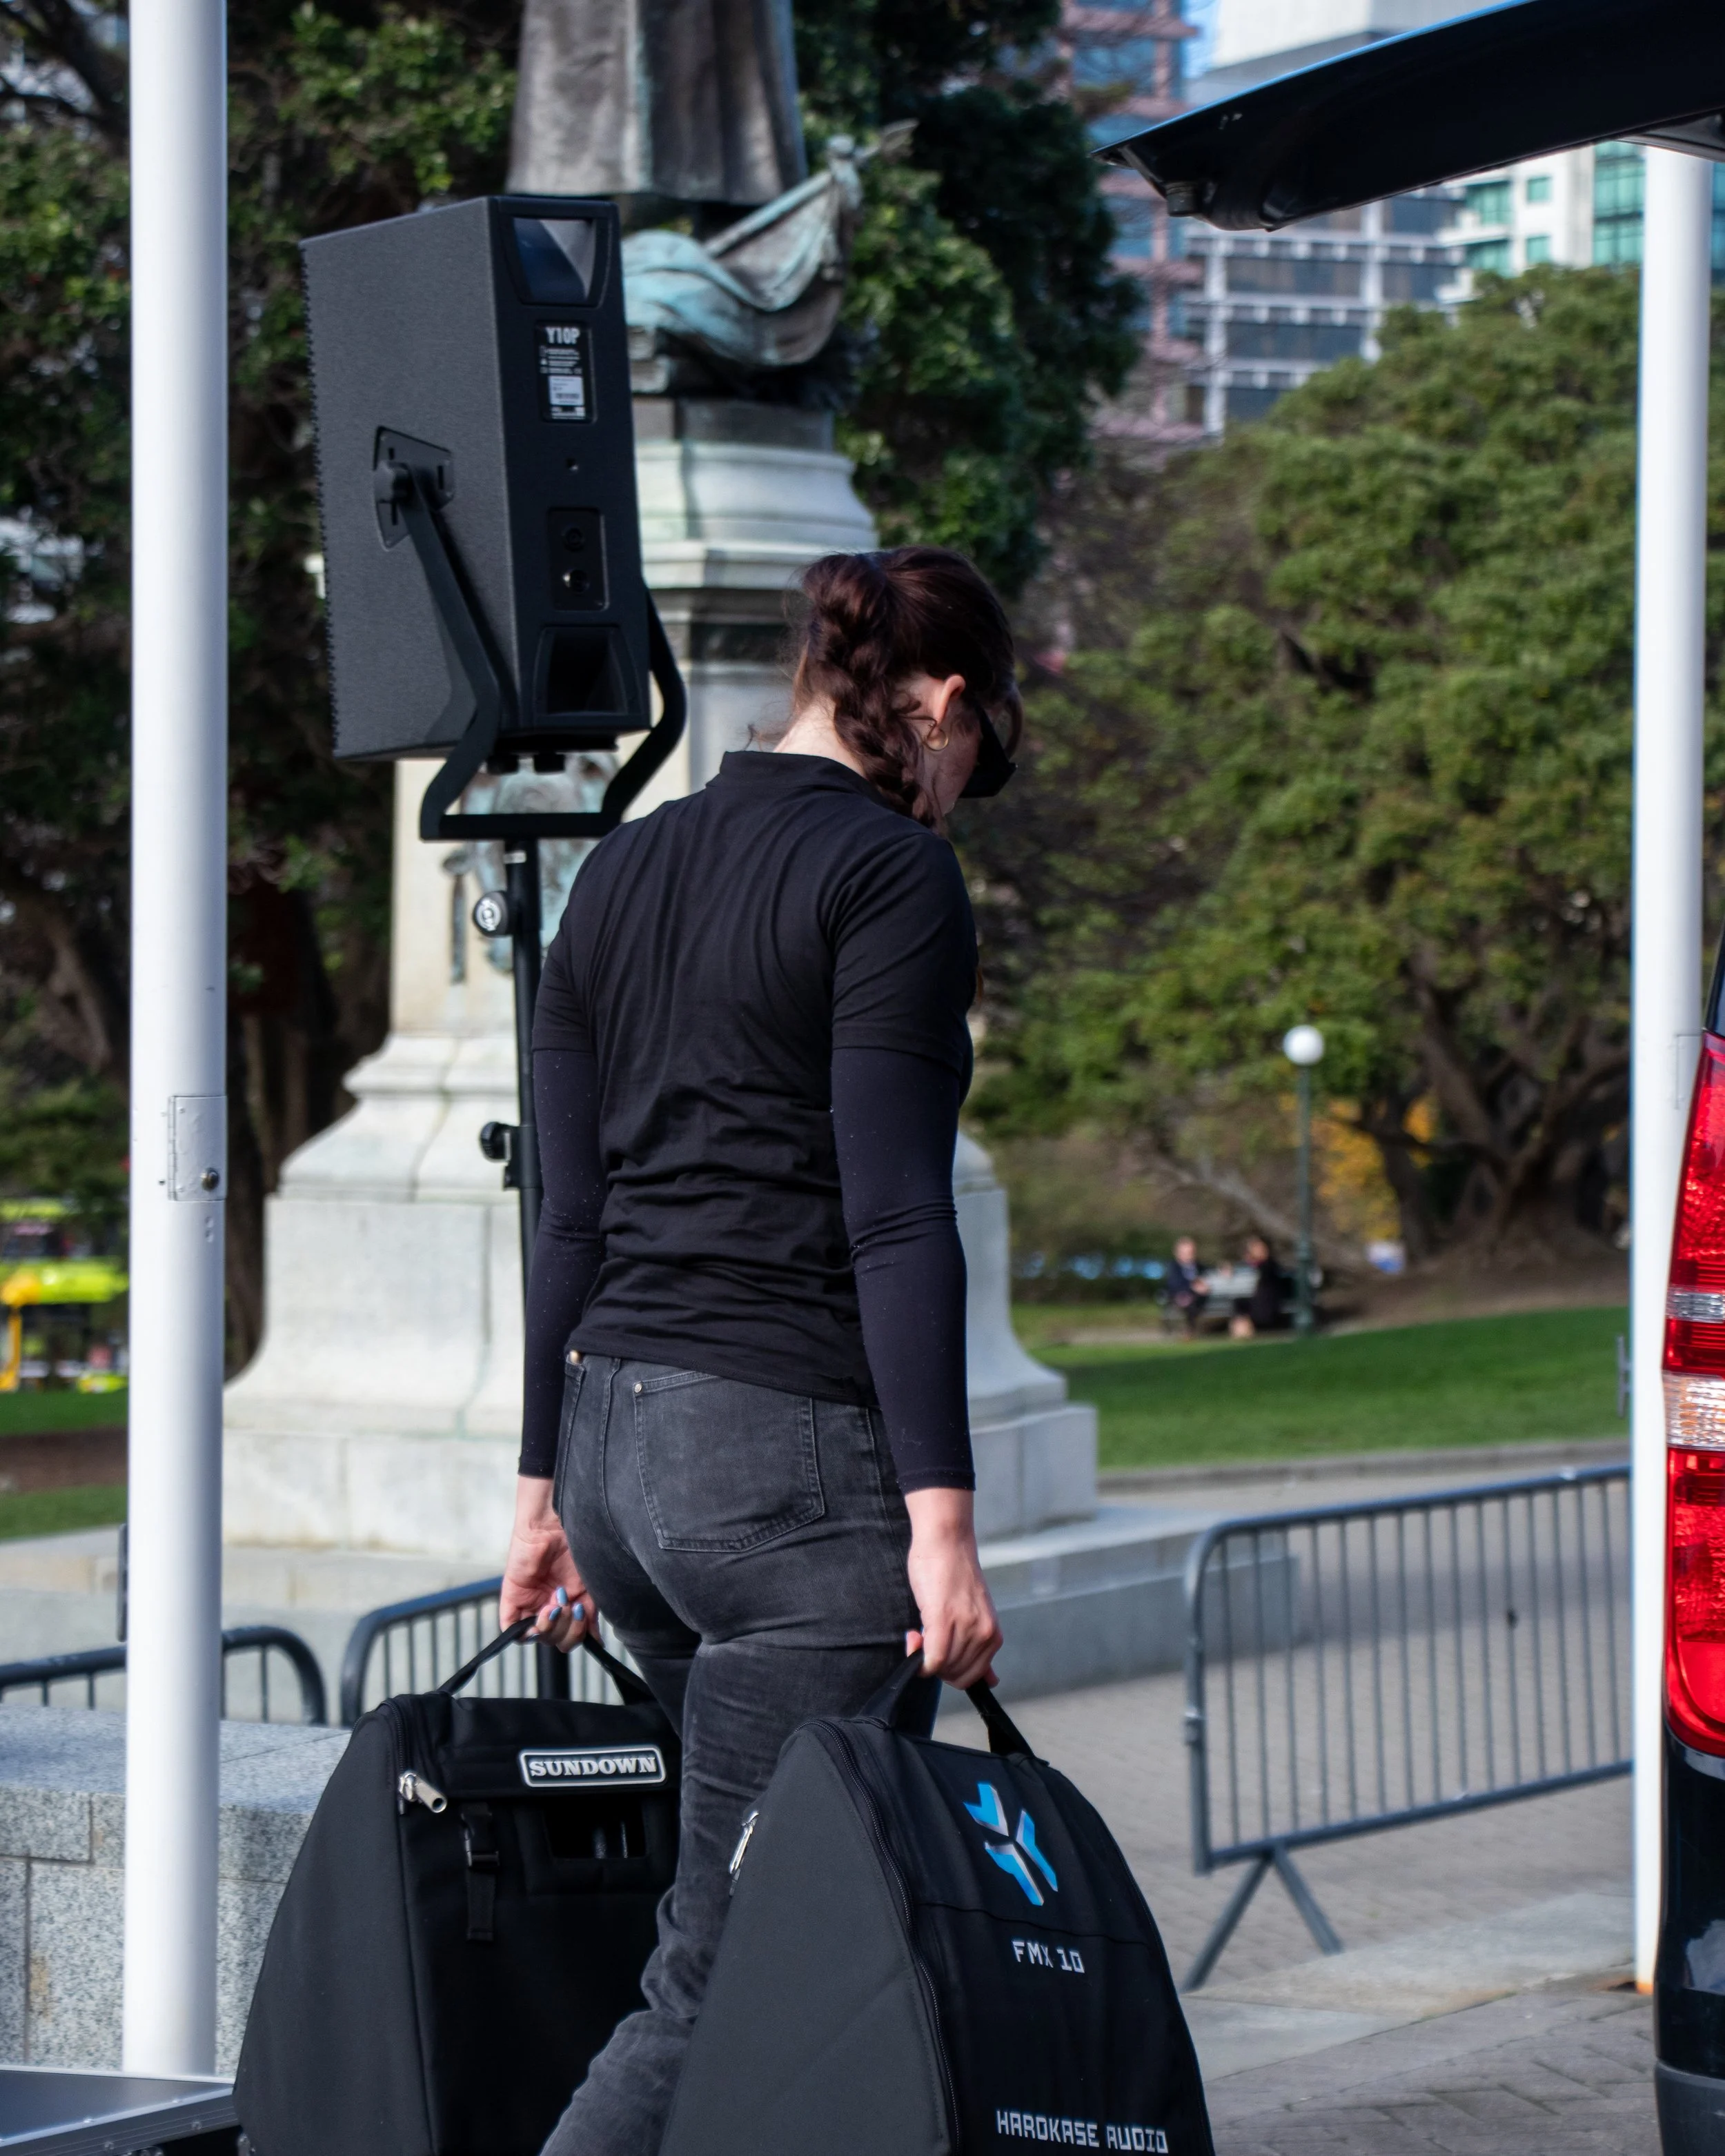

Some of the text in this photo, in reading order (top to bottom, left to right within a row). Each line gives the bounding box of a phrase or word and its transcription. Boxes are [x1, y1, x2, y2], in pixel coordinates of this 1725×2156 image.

[545, 326, 580, 344] Y10P
[529, 1757, 658, 1777] SUNDOWN
[1012, 1939, 1085, 1973] FMX 10
[996, 2109, 1169, 2154] HARDKASE AUDIO
